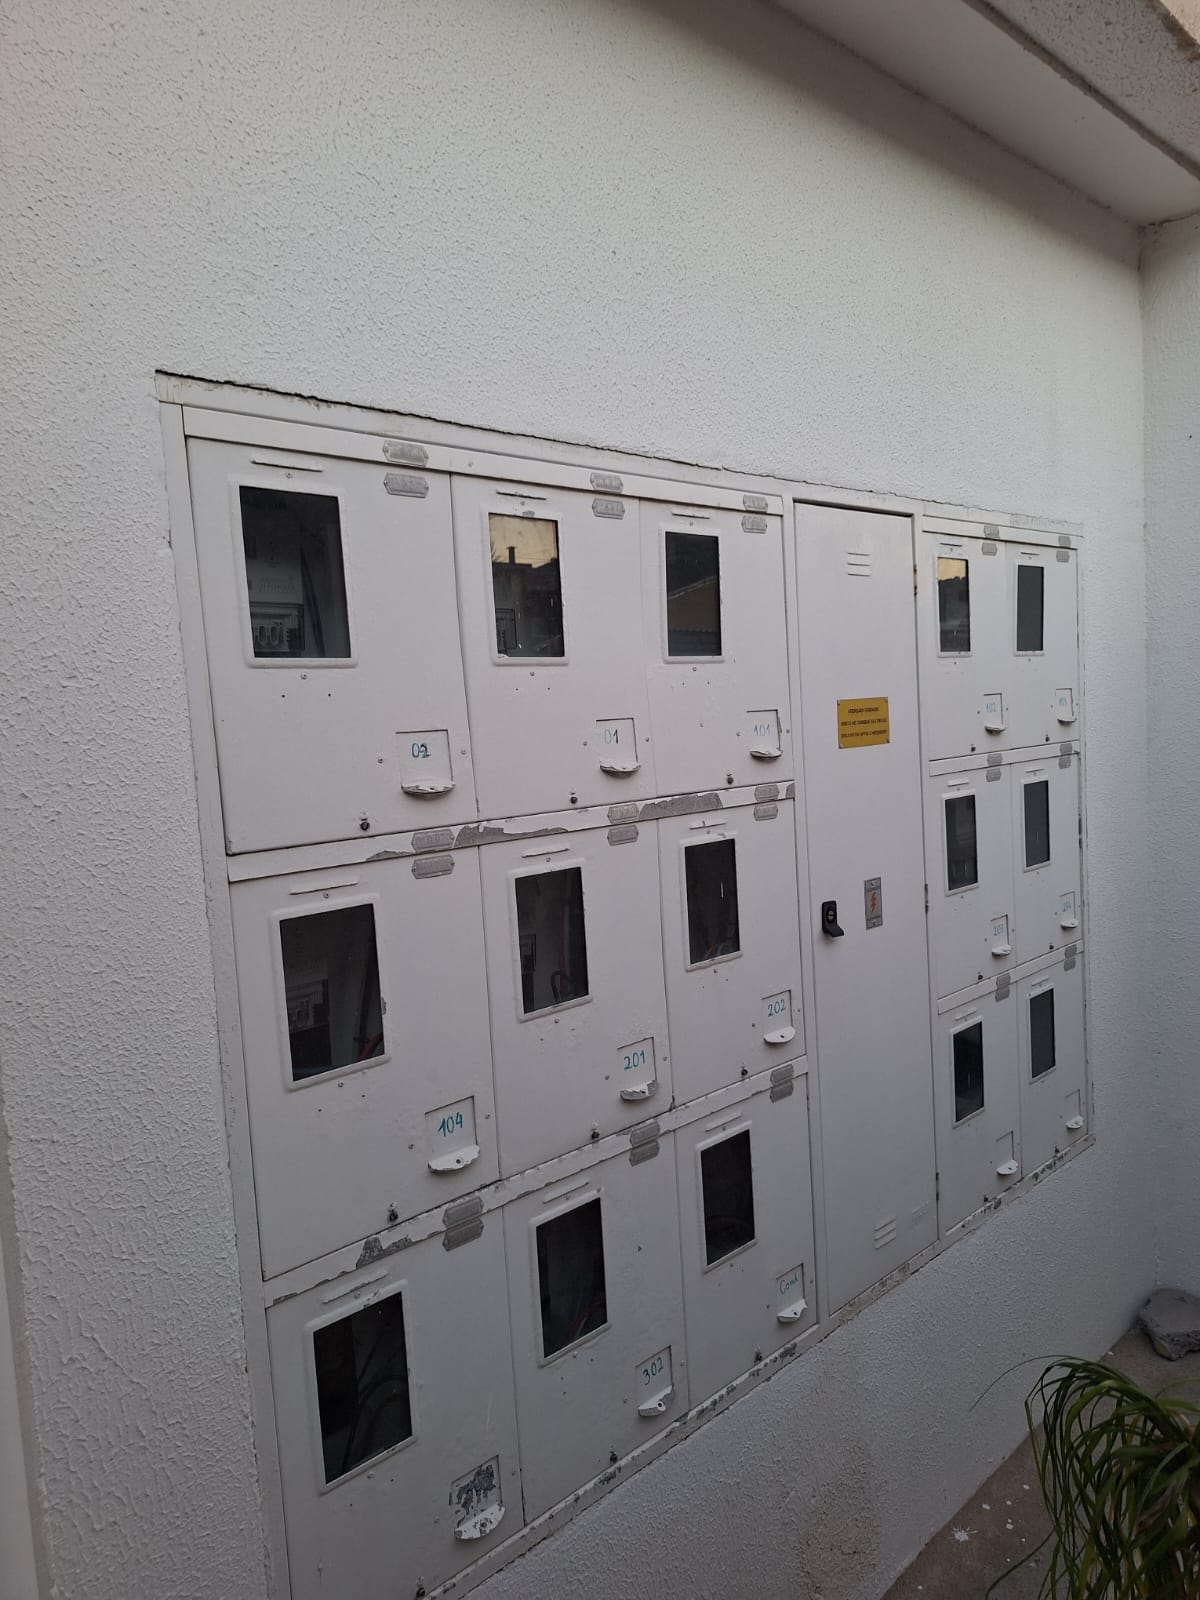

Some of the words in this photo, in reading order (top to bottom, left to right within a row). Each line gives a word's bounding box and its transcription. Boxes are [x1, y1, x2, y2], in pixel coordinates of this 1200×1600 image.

[604, 729, 618, 745] 01
[754, 724, 771, 737] 101
[767, 998, 786, 1017] 202
[624, 1050, 646, 1071] 201
[438, 1111, 463, 1137] 104
[642, 1356, 664, 1386] 302
